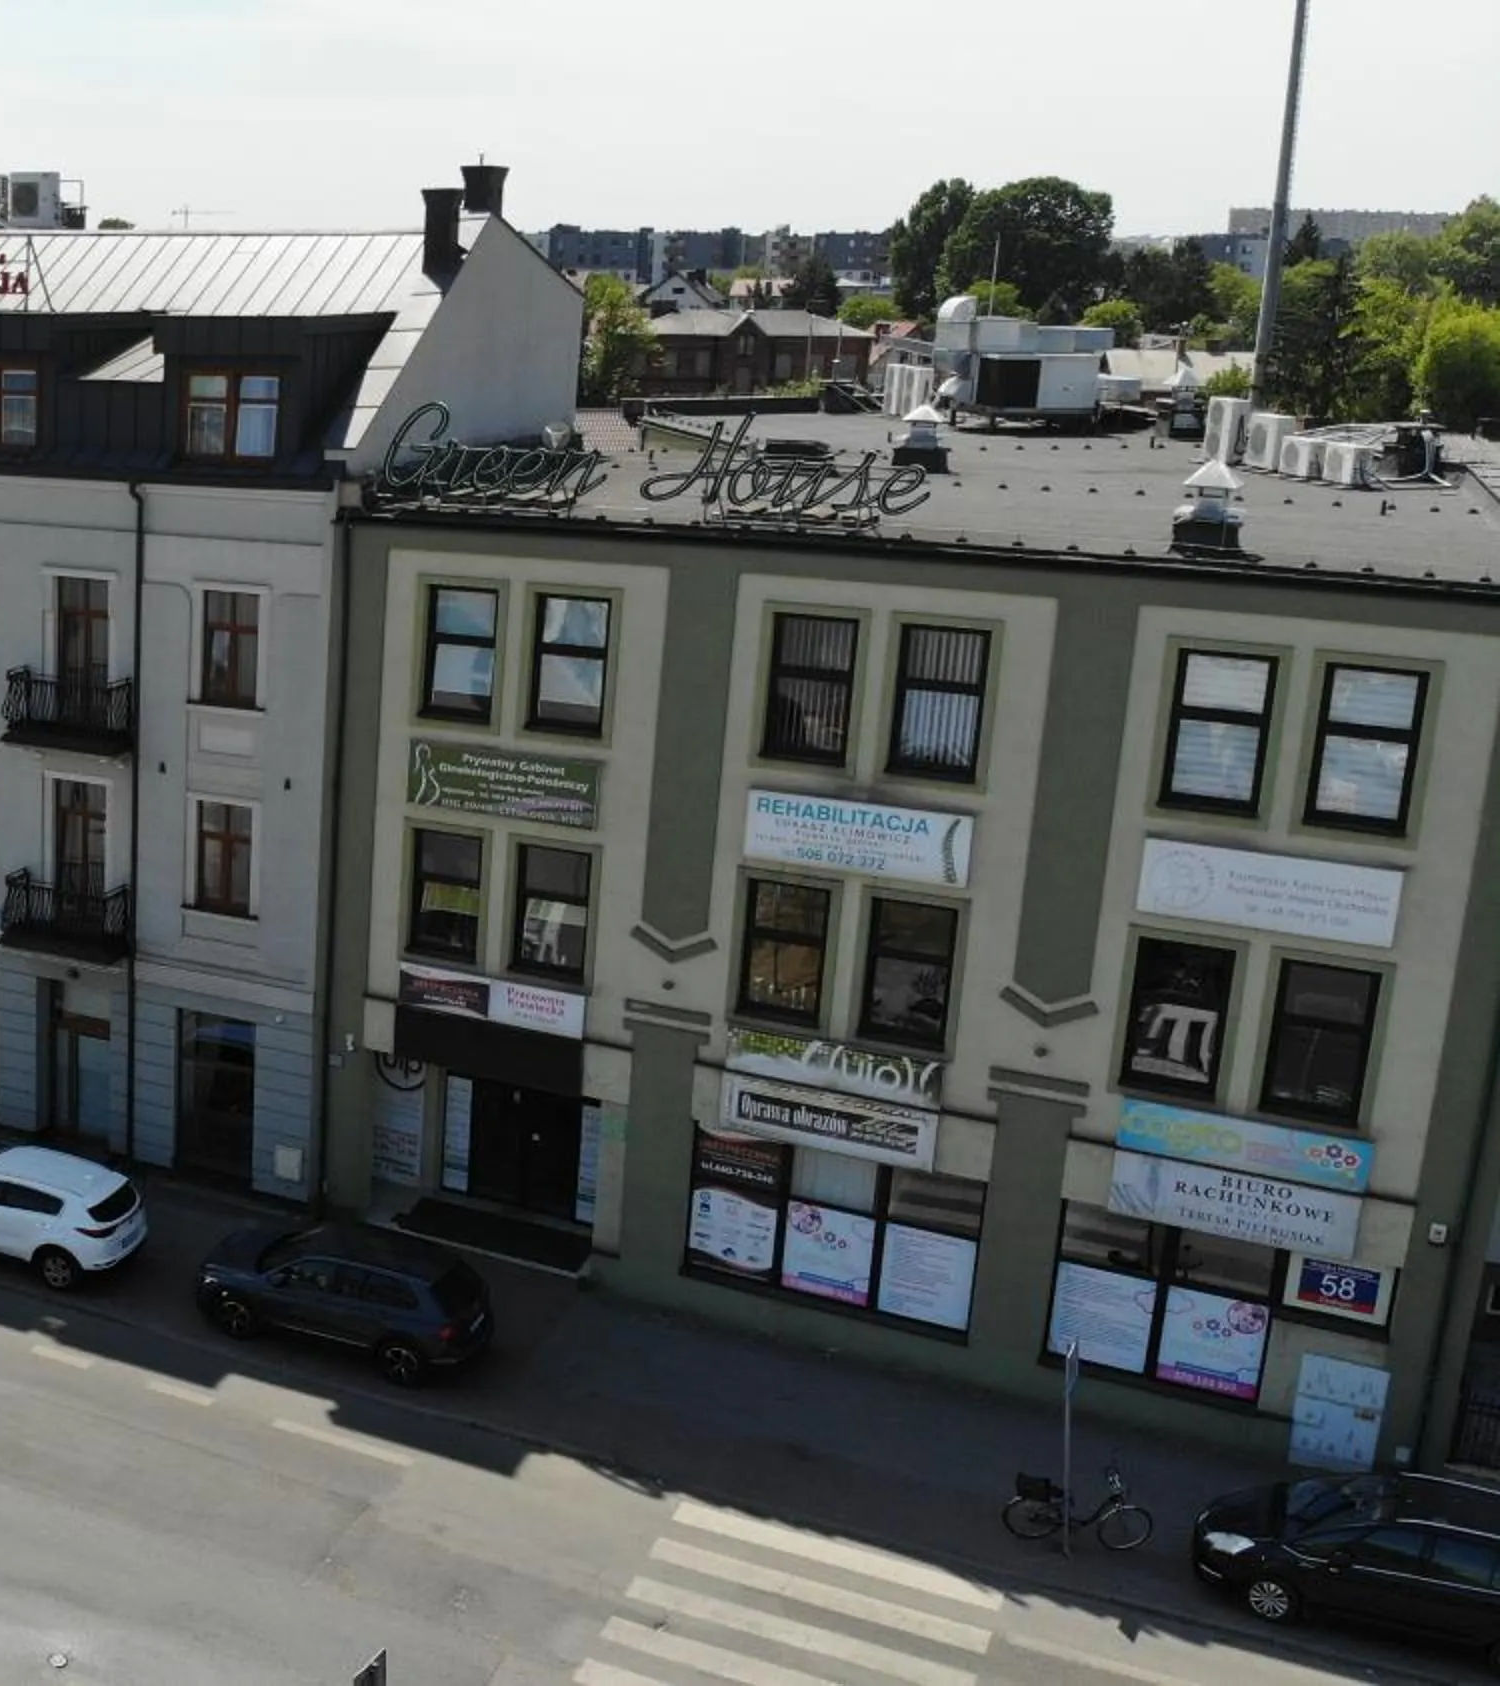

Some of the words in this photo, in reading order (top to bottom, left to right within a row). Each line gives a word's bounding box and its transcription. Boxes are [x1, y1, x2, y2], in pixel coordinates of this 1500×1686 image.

[382, 400, 608, 497] Green
[639, 411, 931, 516] House
[462, 753, 516, 771] Prywatny
[519, 761, 565, 776] Gabinet
[756, 796, 930, 835] REHABILITACJA
[740, 1093, 790, 1124] Oprawa
[793, 1106, 848, 1135] obrazów
[1174, 1180, 1335, 1224] RACHUNKOWE
[1220, 1174, 1293, 1200] BIURO
[1319, 1274, 1357, 1300] 58
